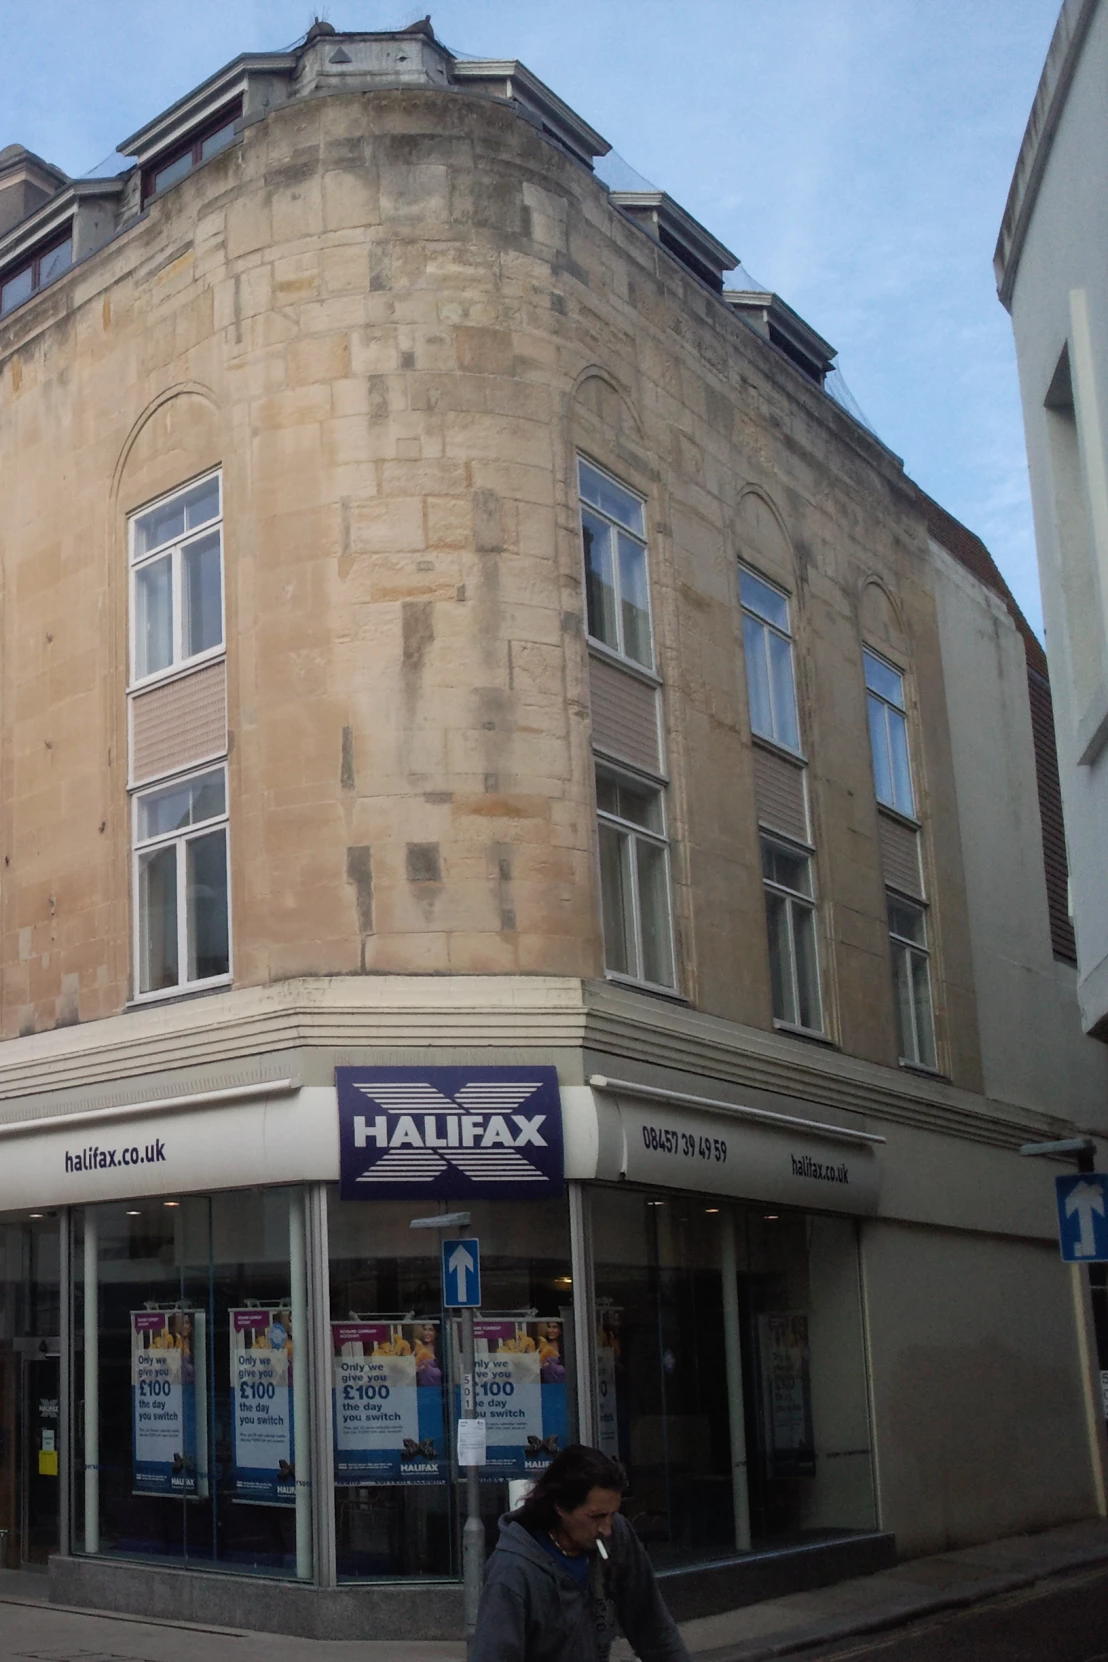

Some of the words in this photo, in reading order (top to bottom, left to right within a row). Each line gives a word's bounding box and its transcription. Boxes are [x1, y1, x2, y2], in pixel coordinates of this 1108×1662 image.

[353, 1114, 549, 1148] HALIFAX
[642, 1125, 679, 1155] 08457
[681, 1133, 695, 1157] 39
[698, 1136, 712, 1161] 49
[713, 1138, 728, 1164] 59
[65, 1138, 167, 1173] halifax.co.uk
[790, 1153, 849, 1185] halifax.co.uk
[138, 1355, 154, 1366] Only
[238, 1355, 257, 1367] Only
[259, 1357, 272, 1365] we
[474, 1359, 490, 1370] nly
[138, 1368, 154, 1378] give
[154, 1369, 169, 1378] you
[238, 1368, 256, 1379] give
[258, 1369, 273, 1379] you
[341, 1363, 365, 1373] Only
[341, 1373, 364, 1384] give
[367, 1375, 387, 1383] you
[491, 1371, 512, 1380] you
[139, 1379, 171, 1397] £100
[240, 1381, 275, 1399] £100
[342, 1384, 390, 1400] £100
[38, 1404, 59, 1413] HALIFAX
[138, 1400, 151, 1408] the
[152, 1400, 166, 1410] day
[239, 1402, 253, 1412] the
[255, 1402, 270, 1414] day
[342, 1402, 360, 1411] the
[363, 1402, 383, 1412] day
[487, 1399, 508, 1409] day
[138, 1412, 151, 1422] you
[153, 1411, 178, 1421] switch
[342, 1413, 362, 1423] you
[365, 1412, 401, 1421] switch
[490, 1409, 526, 1418] switch
[239, 1416, 255, 1426] you
[257, 1415, 284, 1426] switch
[400, 1464, 439, 1472] HALIFAX
